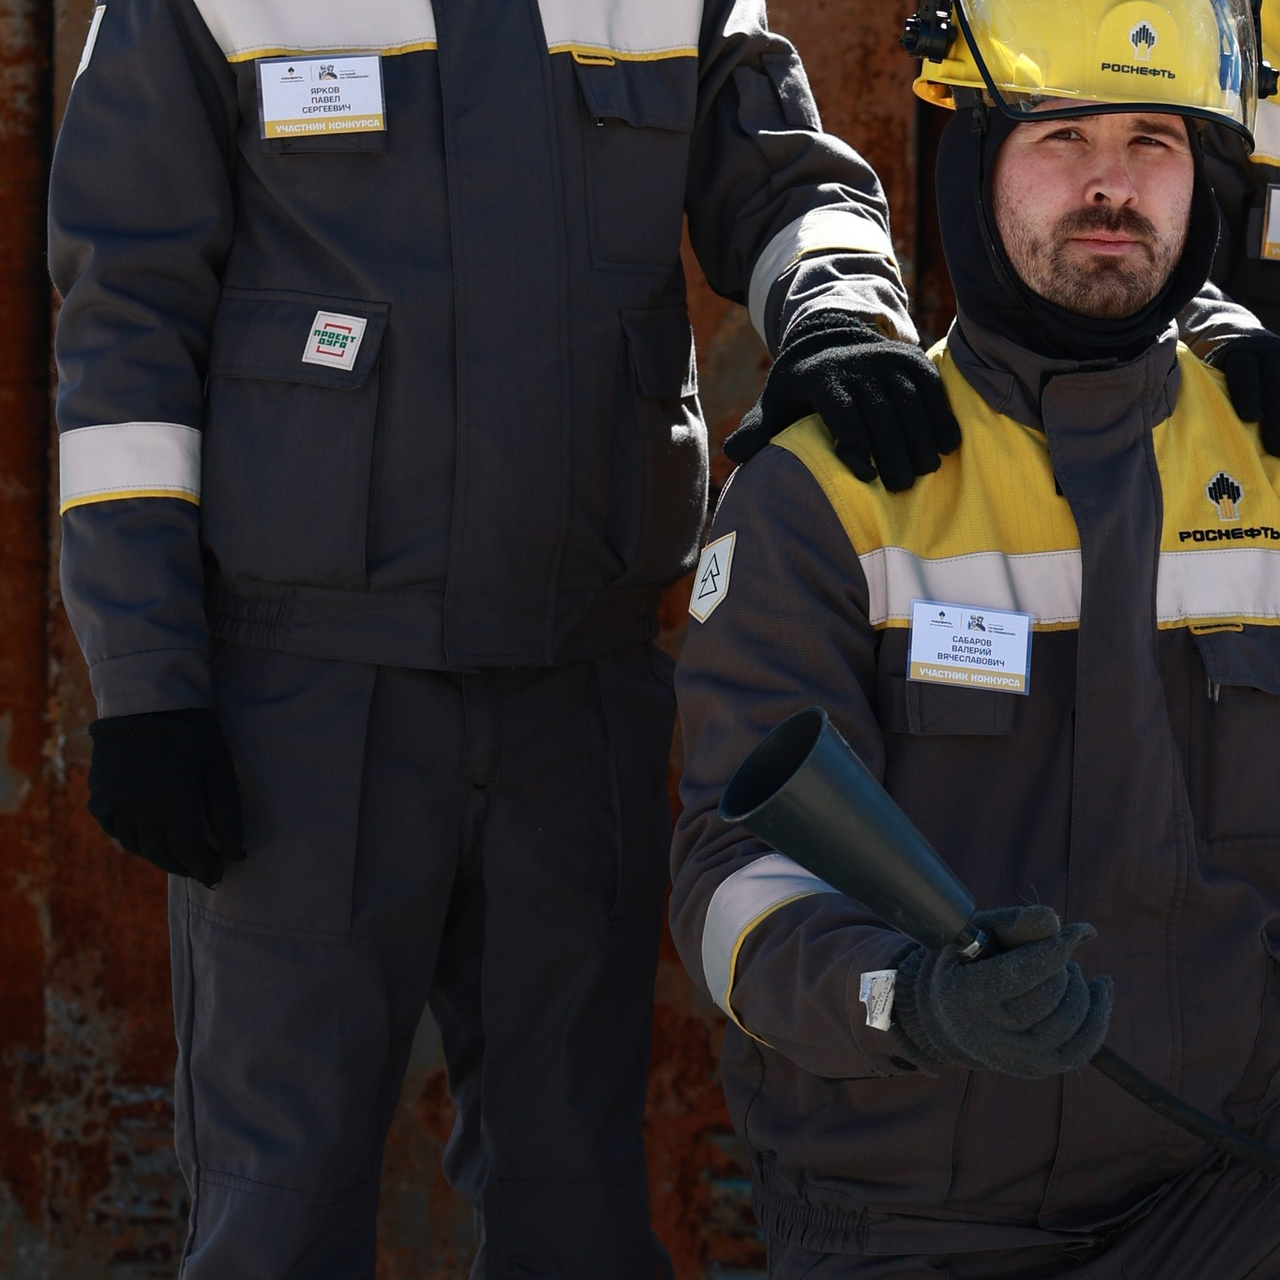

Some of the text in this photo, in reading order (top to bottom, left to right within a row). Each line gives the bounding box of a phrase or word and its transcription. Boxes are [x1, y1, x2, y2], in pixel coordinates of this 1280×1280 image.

[1101, 62, 1176, 79] РОСНЕФТЬ
[310, 86, 340, 95] ЯРКОВ
[311, 95, 341, 104] ПАВЕЛ
[302, 104, 351, 114] СЕРГЕЕВИЧ
[275, 119, 380, 133] УЧАСТНИК КОНКУРСА
[313, 329, 357, 343] ПРОЕКТ
[318, 338, 347, 349] ДУГА
[1178, 526, 1280, 542] РОСНЕФТЬ
[952, 635, 992, 647] САБАРОВ
[952, 645, 992, 656] ВАЛЕРИЙ
[937, 652, 1005, 667] ВЯЧЕСЛАВОВИЧ
[919, 667, 1021, 687] УЧАСТНИК КОНКУРСА
